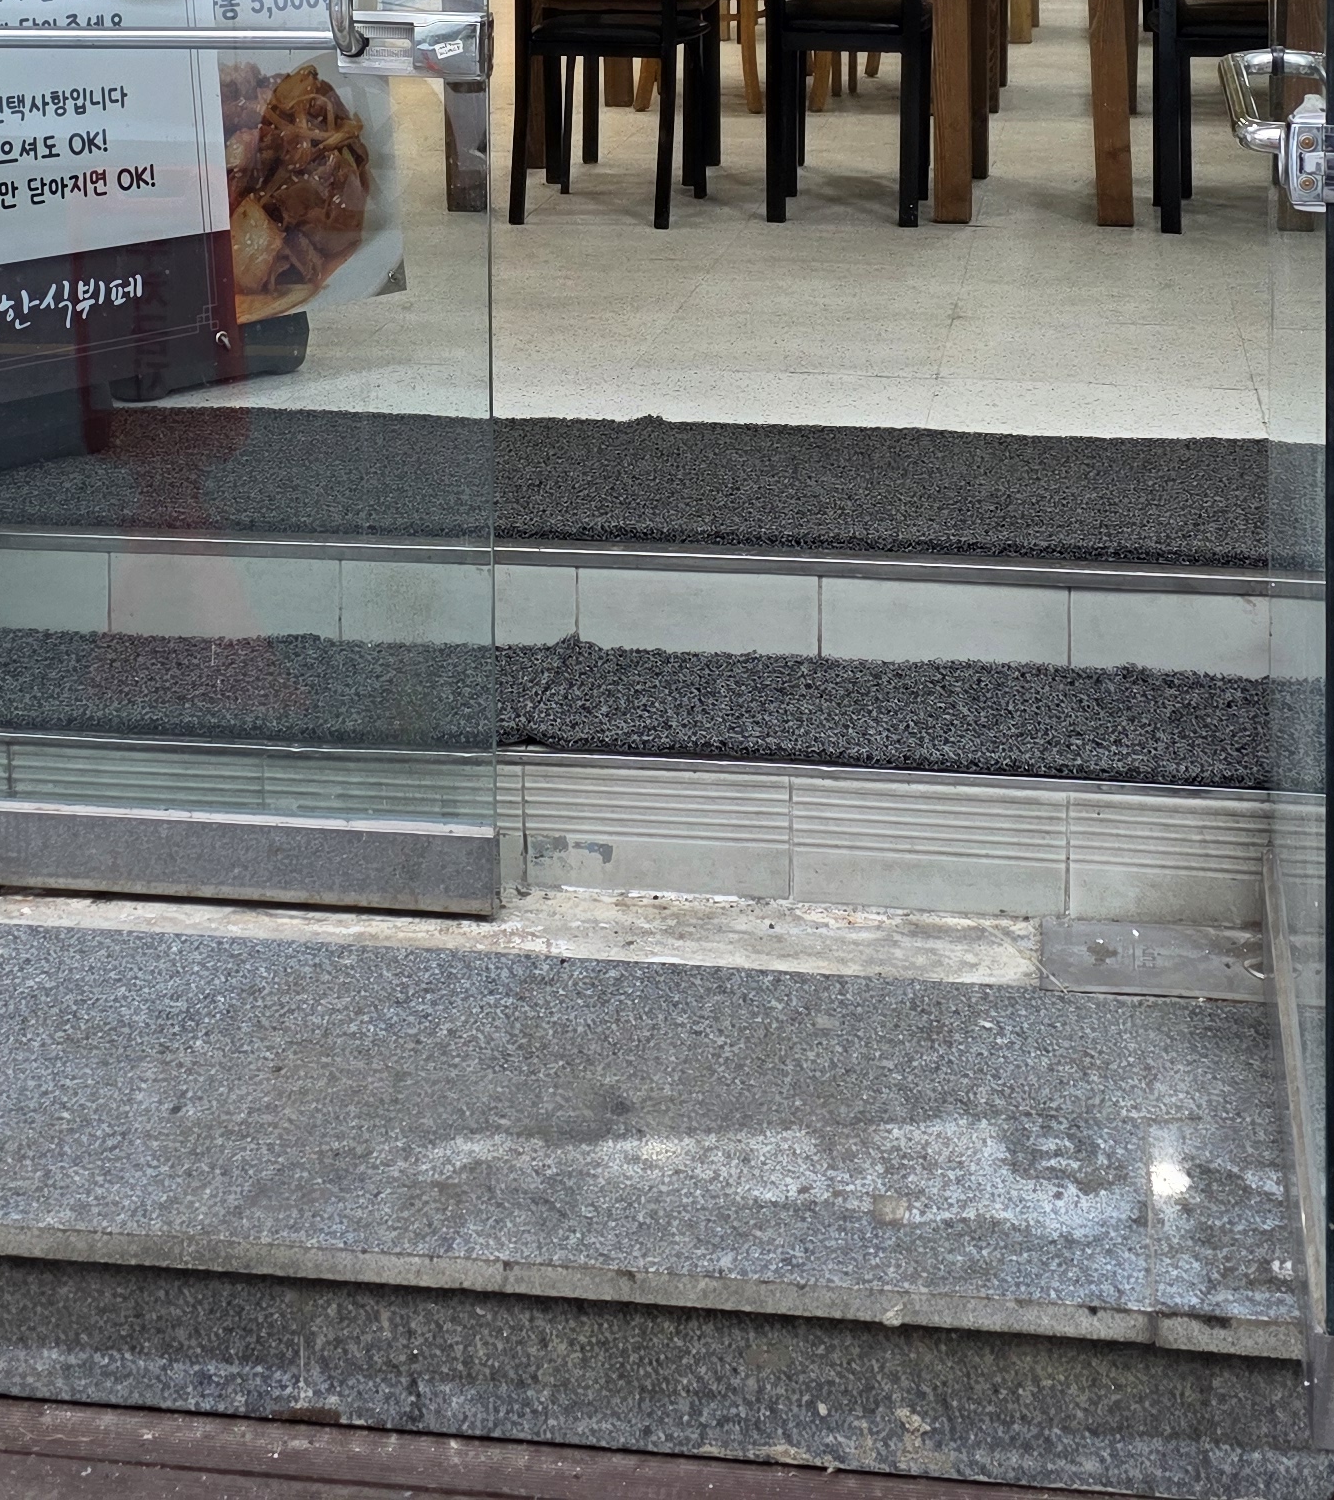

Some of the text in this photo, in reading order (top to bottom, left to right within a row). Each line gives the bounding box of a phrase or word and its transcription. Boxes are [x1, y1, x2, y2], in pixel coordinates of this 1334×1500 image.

[68, 128, 109, 156] OK!
[27, 169, 108, 205] 닫아지면
[117, 163, 156, 191] OK!
